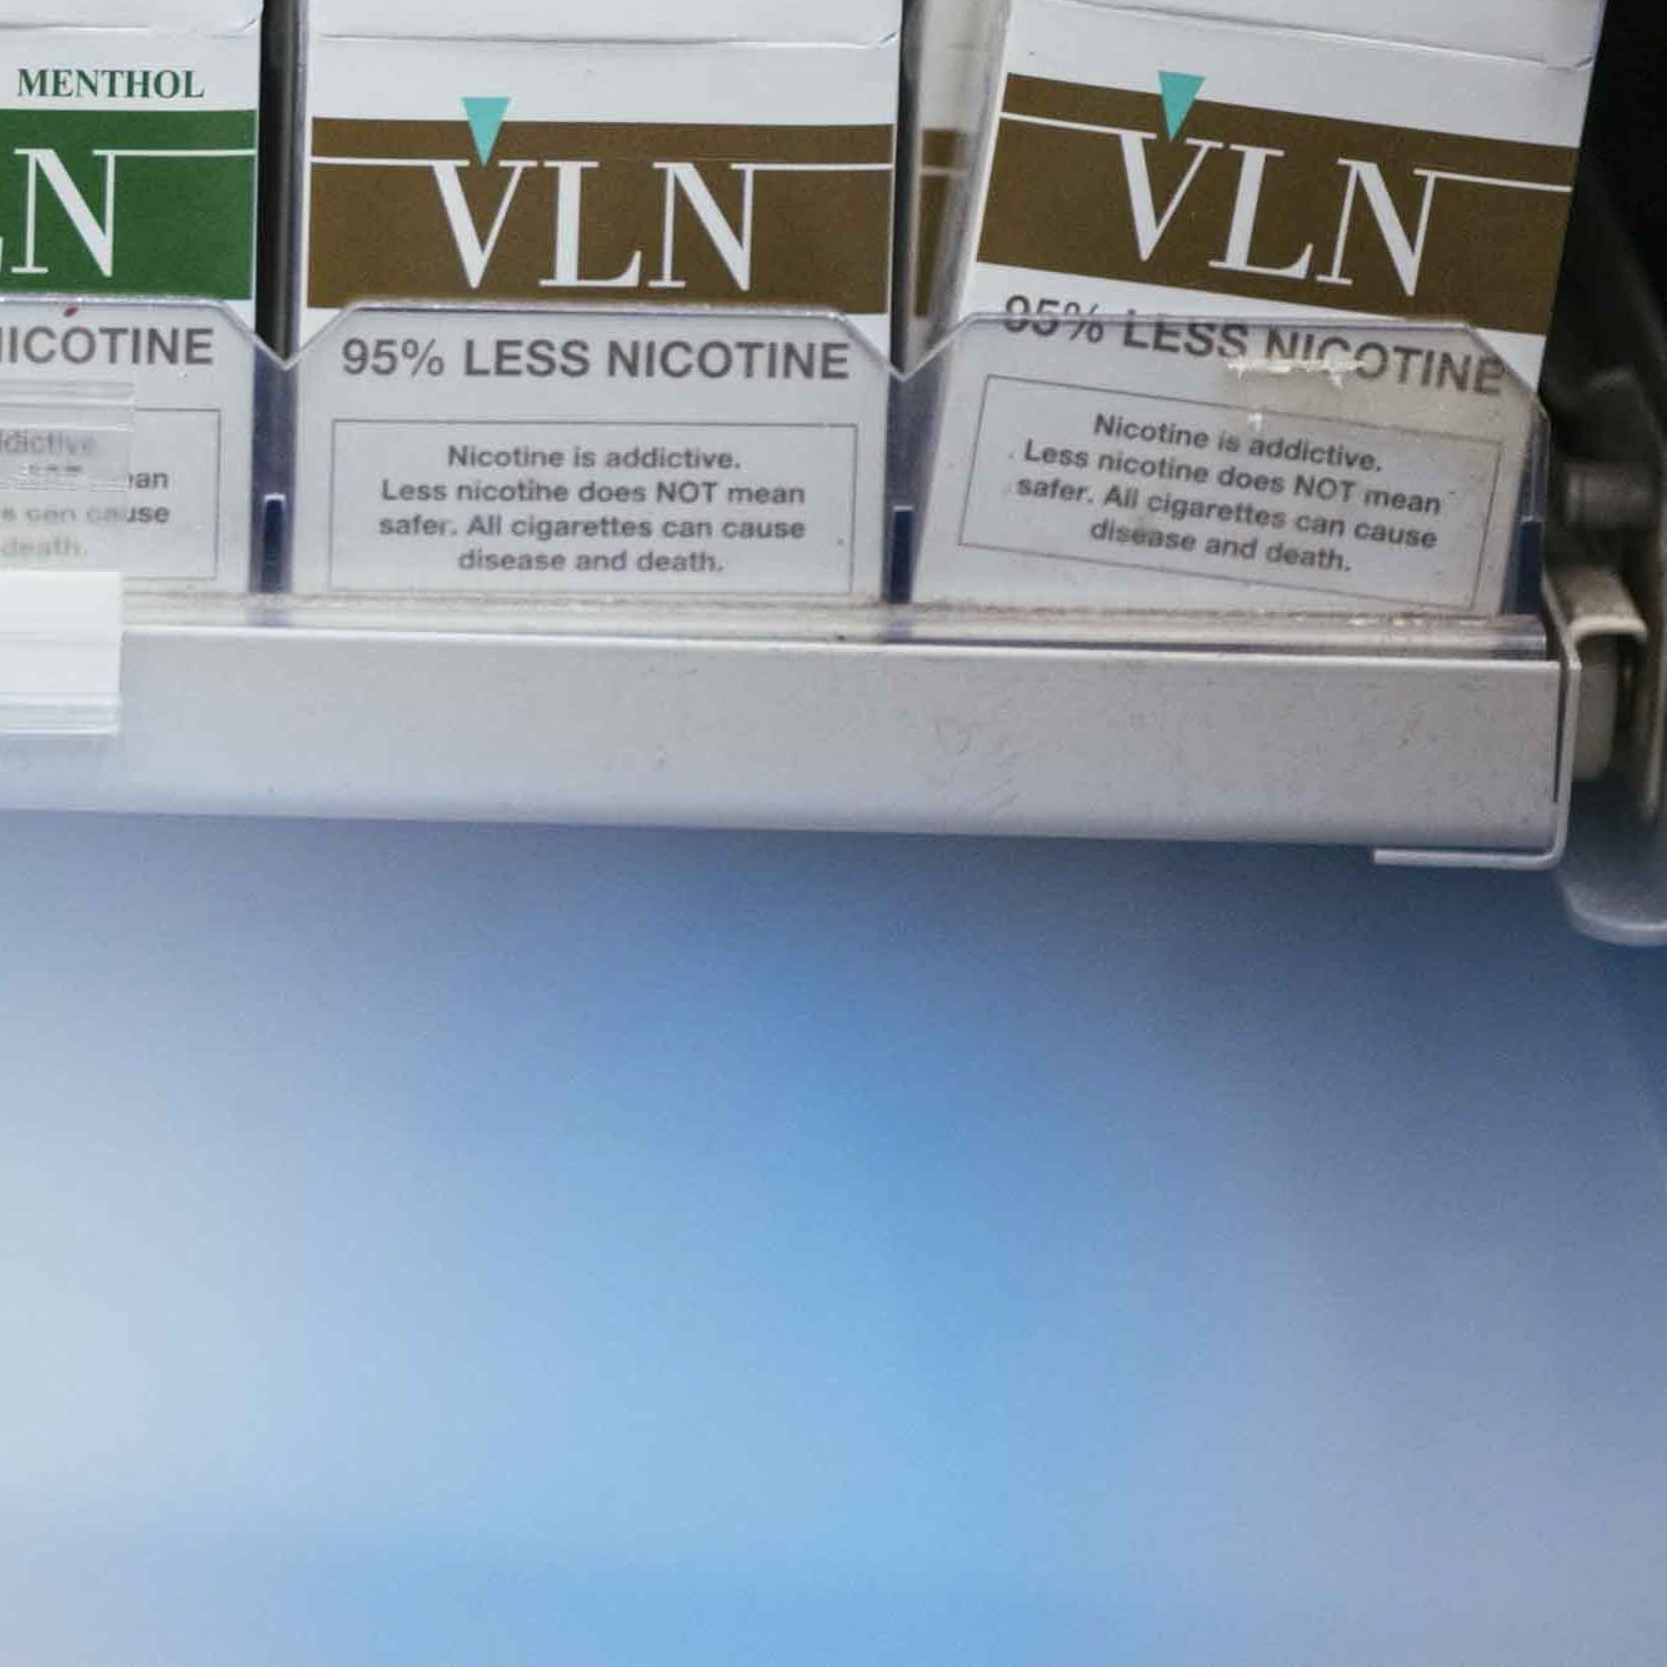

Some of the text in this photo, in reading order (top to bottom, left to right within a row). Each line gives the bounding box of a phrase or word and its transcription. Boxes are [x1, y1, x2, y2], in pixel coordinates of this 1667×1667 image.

[17, 67, 205, 100] MENTHOL
[430, 159, 755, 293] VLN
[1118, 129, 1441, 298] VLN
[341, 337, 850, 381] 95% LESS NICOTINE
[1003, 293, 1507, 397] 95% LESS NICOTINE
[447, 444, 742, 471] Nicotine is addictive.
[1093, 412, 1384, 474] Nicotine is addictive.
[380, 479, 806, 506] Less nicotine does NOT mean
[1023, 438, 1442, 516] Less nicotine does NOT mean
[378, 513, 806, 542] safer. All cigarettes can cause
[1015, 475, 1439, 550] safer. All cigarettes can cause
[457, 548, 725, 574] disease and death.
[1089, 517, 1353, 575] disease and death.
